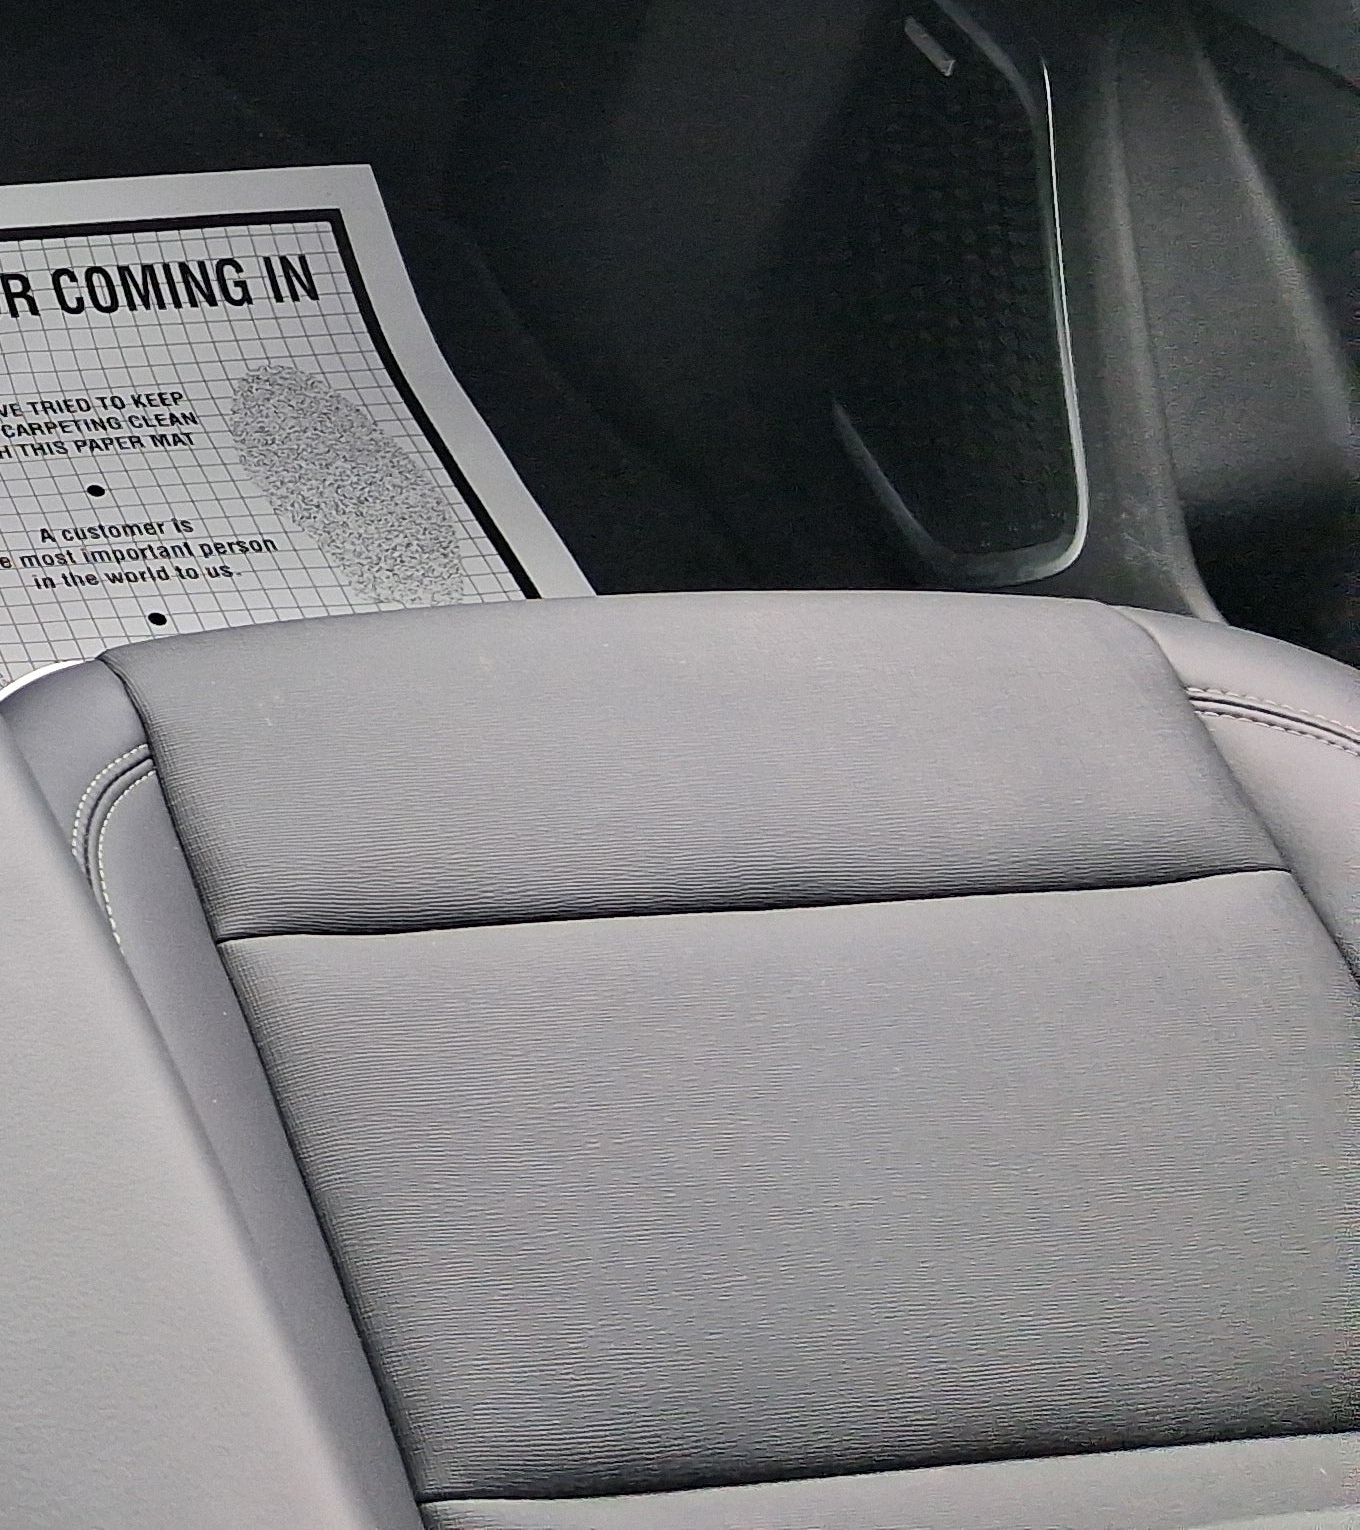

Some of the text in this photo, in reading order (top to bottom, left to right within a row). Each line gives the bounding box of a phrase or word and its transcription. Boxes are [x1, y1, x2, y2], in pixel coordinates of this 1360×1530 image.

[51, 258, 253, 315] COMING
[264, 254, 320, 303] IN
[27, 397, 91, 415] TRIED
[95, 395, 126, 411] TO
[130, 390, 184, 409] KEEP
[1, 418, 122, 439] CARPETING
[128, 411, 199, 429] CLEAN
[20, 440, 69, 457] THIS
[72, 434, 145, 454] PAPER
[150, 432, 195, 447] MAT
[40, 518, 194, 543] A customer is
[19, 550, 76, 568] most
[82, 542, 195, 565] important
[198, 536, 278, 558] person
[33, 563, 242, 590] in the world to us.
